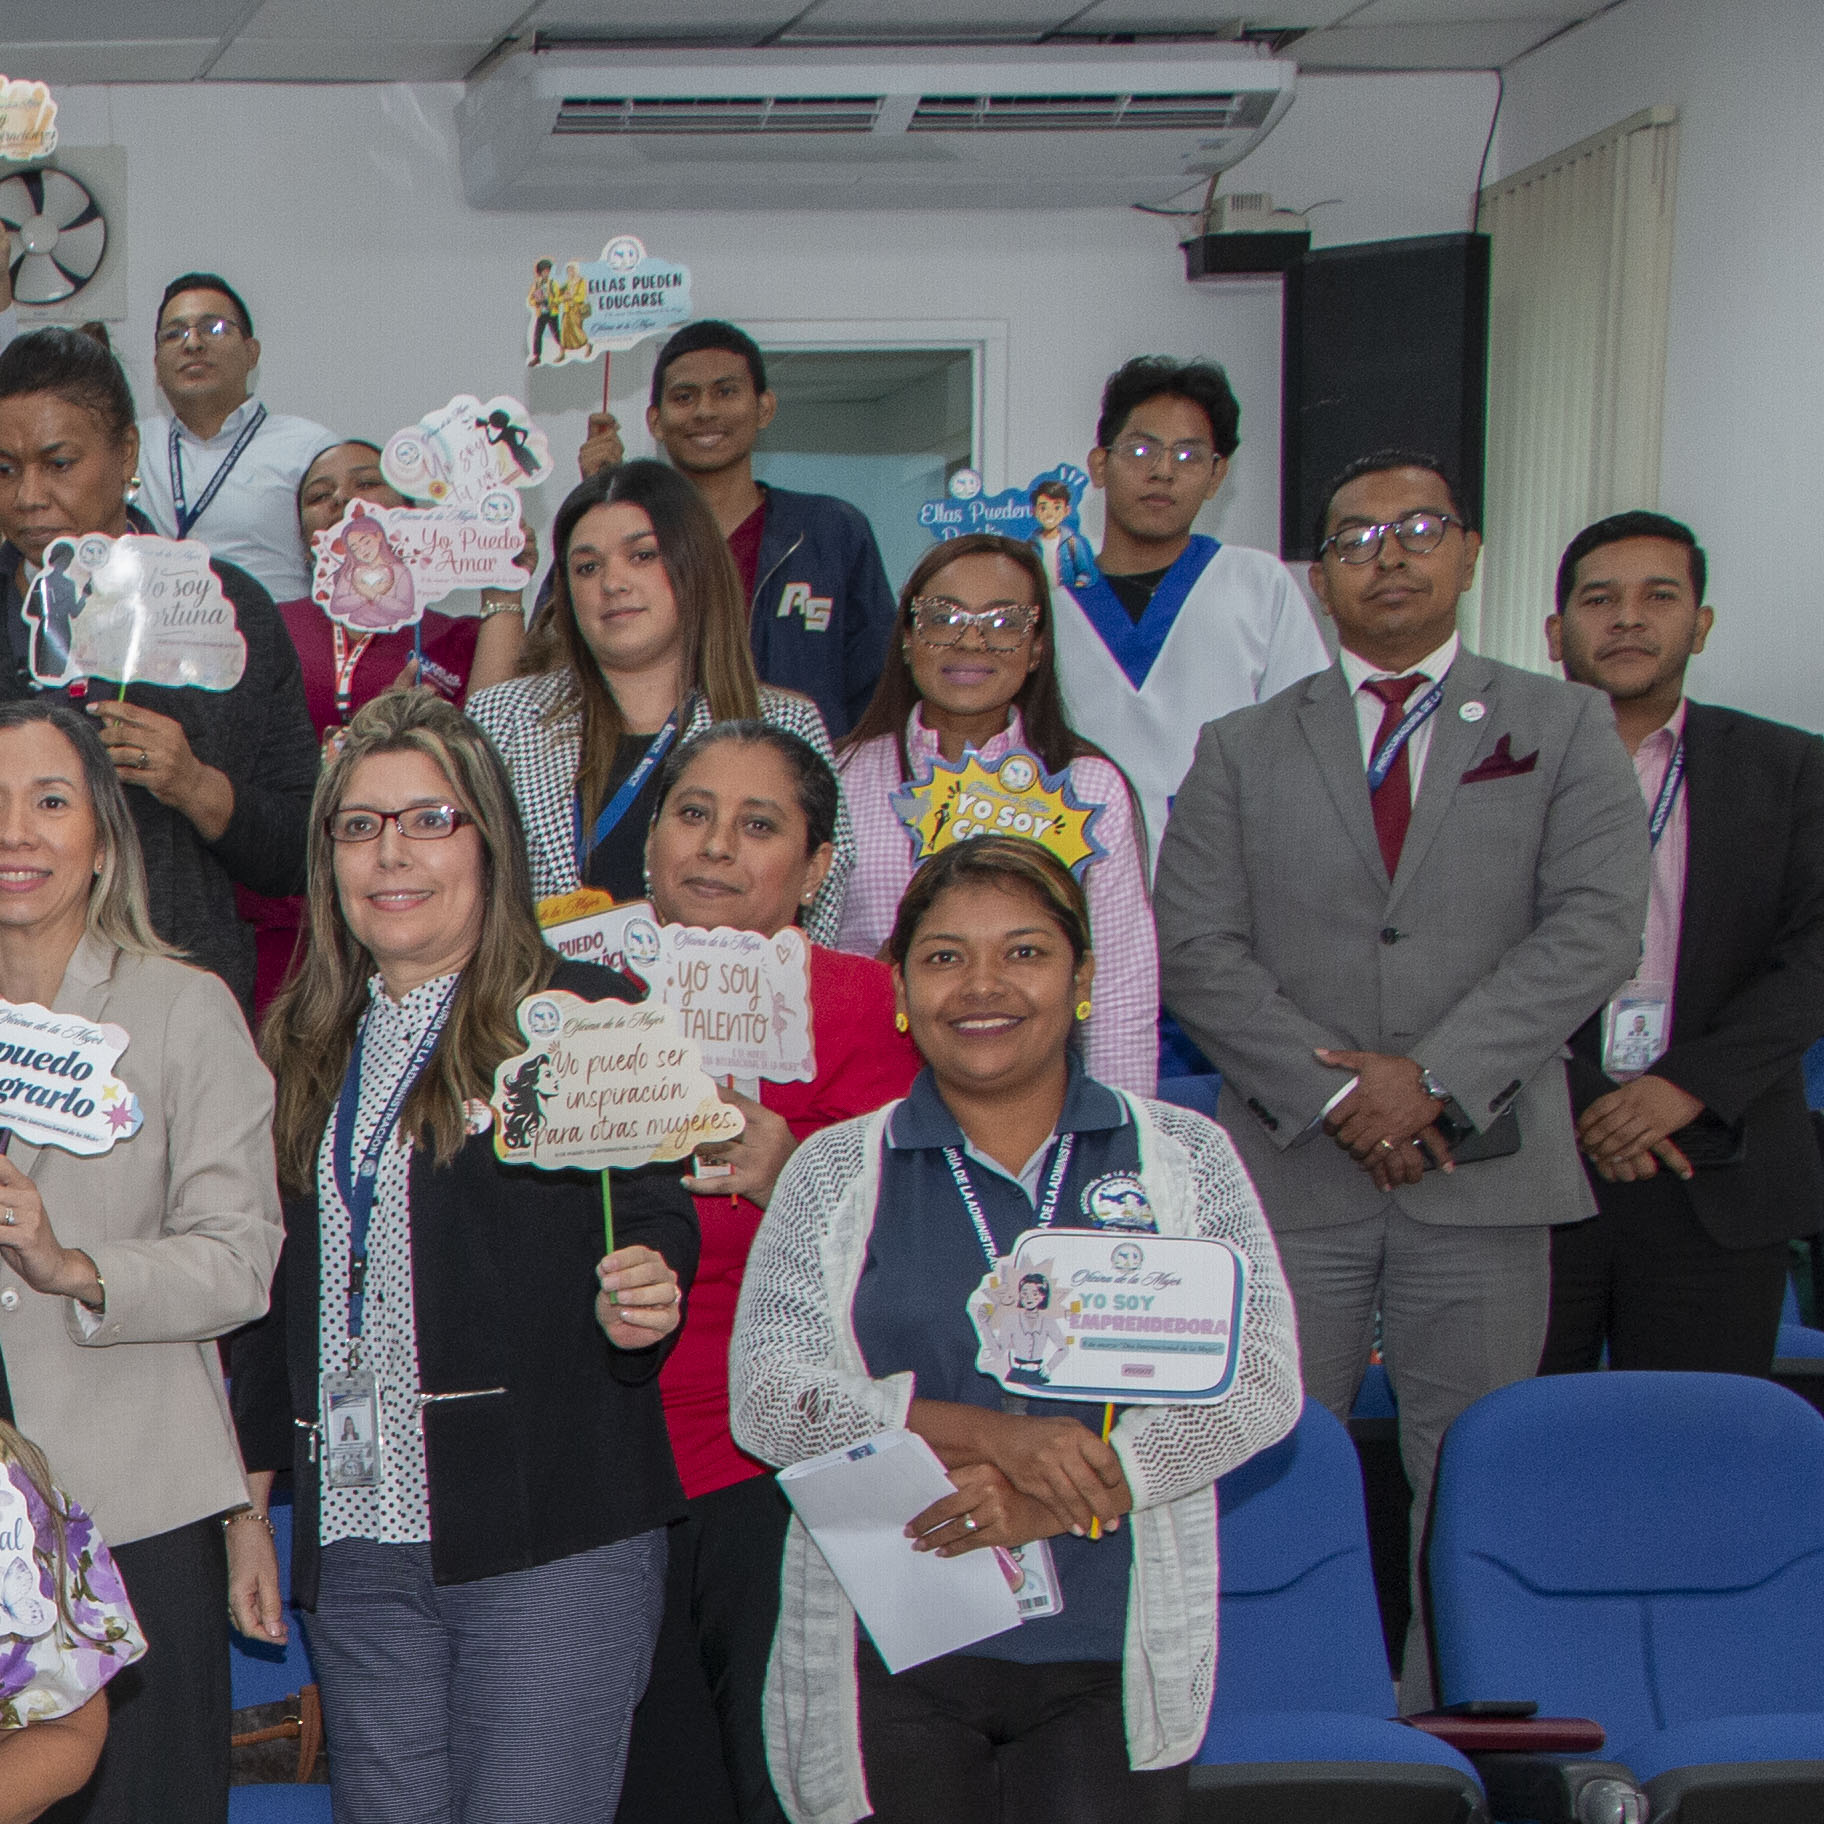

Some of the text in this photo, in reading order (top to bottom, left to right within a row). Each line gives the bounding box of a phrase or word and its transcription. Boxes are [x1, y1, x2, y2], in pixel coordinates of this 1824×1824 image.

[588, 273, 682, 293] ELLAS PUEDEN
[599, 292, 664, 310] EDUCARSE
[920, 499, 1032, 524] Ellas Pueden
[422, 527, 521, 551] Yo Puedo
[435, 550, 497, 575] Amar
[172, 578, 212, 607] soy
[956, 793, 993, 820] YO
[996, 806, 1053, 839] SOY
[559, 931, 604, 957] PUEDO
[678, 960, 710, 1007] yo
[719, 960, 760, 1011] soy
[32, 1021, 48, 1032] de
[50, 1023, 59, 1035] la
[61, 1025, 104, 1045] Mujer
[680, 1008, 769, 1044] TALENTO
[552, 1050, 579, 1079] Yo
[586, 1042, 647, 1083] puedo
[656, 1048, 689, 1068] ser
[368, 1032, 438, 1156] DE LA ADMINISTRACIÓN
[566, 1075, 687, 1117] inspiración
[531, 1125, 583, 1158] para
[590, 1117, 639, 1141] otras
[647, 1113, 737, 1148] mujeres.
[953, 1169, 968, 1186] DE
[959, 1185, 975, 1201] LA
[1079, 1293, 1155, 1311] YO SOY
[1069, 1314, 1228, 1335] EMPRENDEDORA
